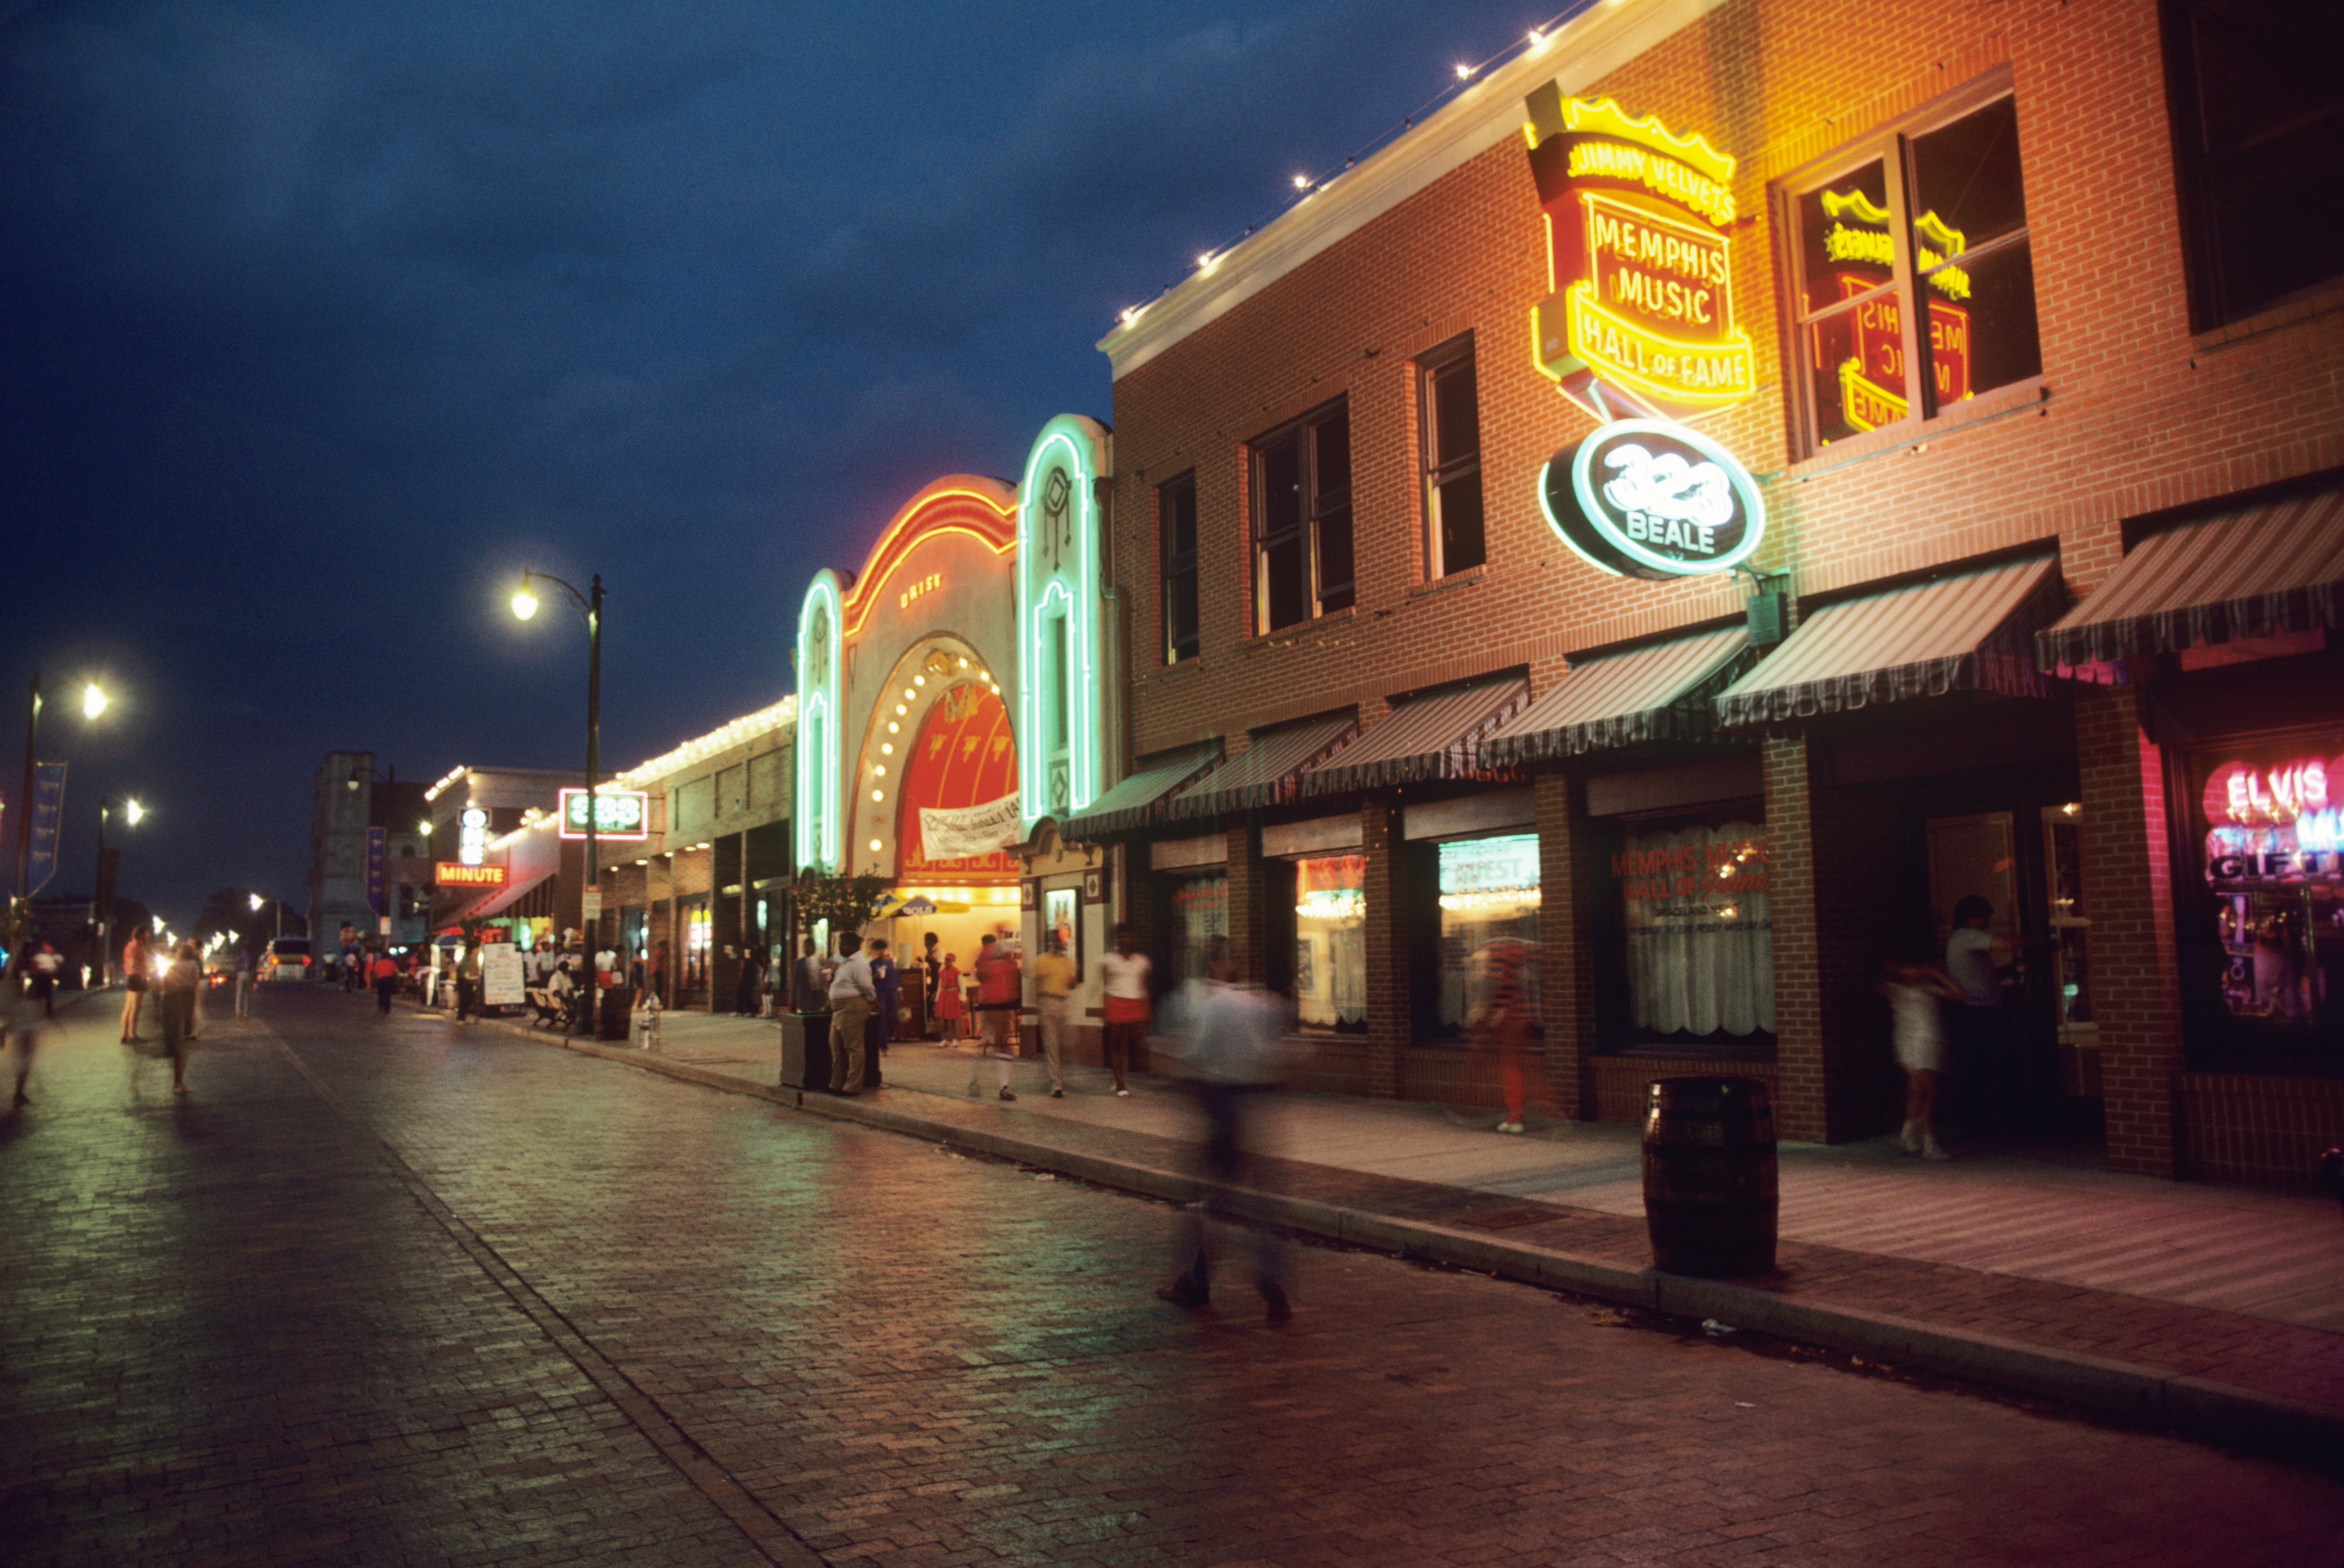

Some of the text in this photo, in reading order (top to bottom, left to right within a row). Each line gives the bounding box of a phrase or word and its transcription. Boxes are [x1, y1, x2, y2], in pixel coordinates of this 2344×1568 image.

[1575, 143, 1735, 222] JIMMY VELVET'S
[1595, 214, 1726, 284] MEMPHIS
[1620, 267, 1711, 323] MUSIC
[1584, 313, 1648, 374] HALL
[1681, 354, 1745, 387] FAME
[1603, 443, 1734, 528] 323
[1626, 511, 1715, 555] BEALE
[2226, 763, 2326, 808] ELVIS
[440, 867, 503, 883] MINUTE
[1611, 845, 1698, 878] MEMPHIS
[1622, 878, 1672, 901] HALL
[1675, 876, 1697, 897] OF
